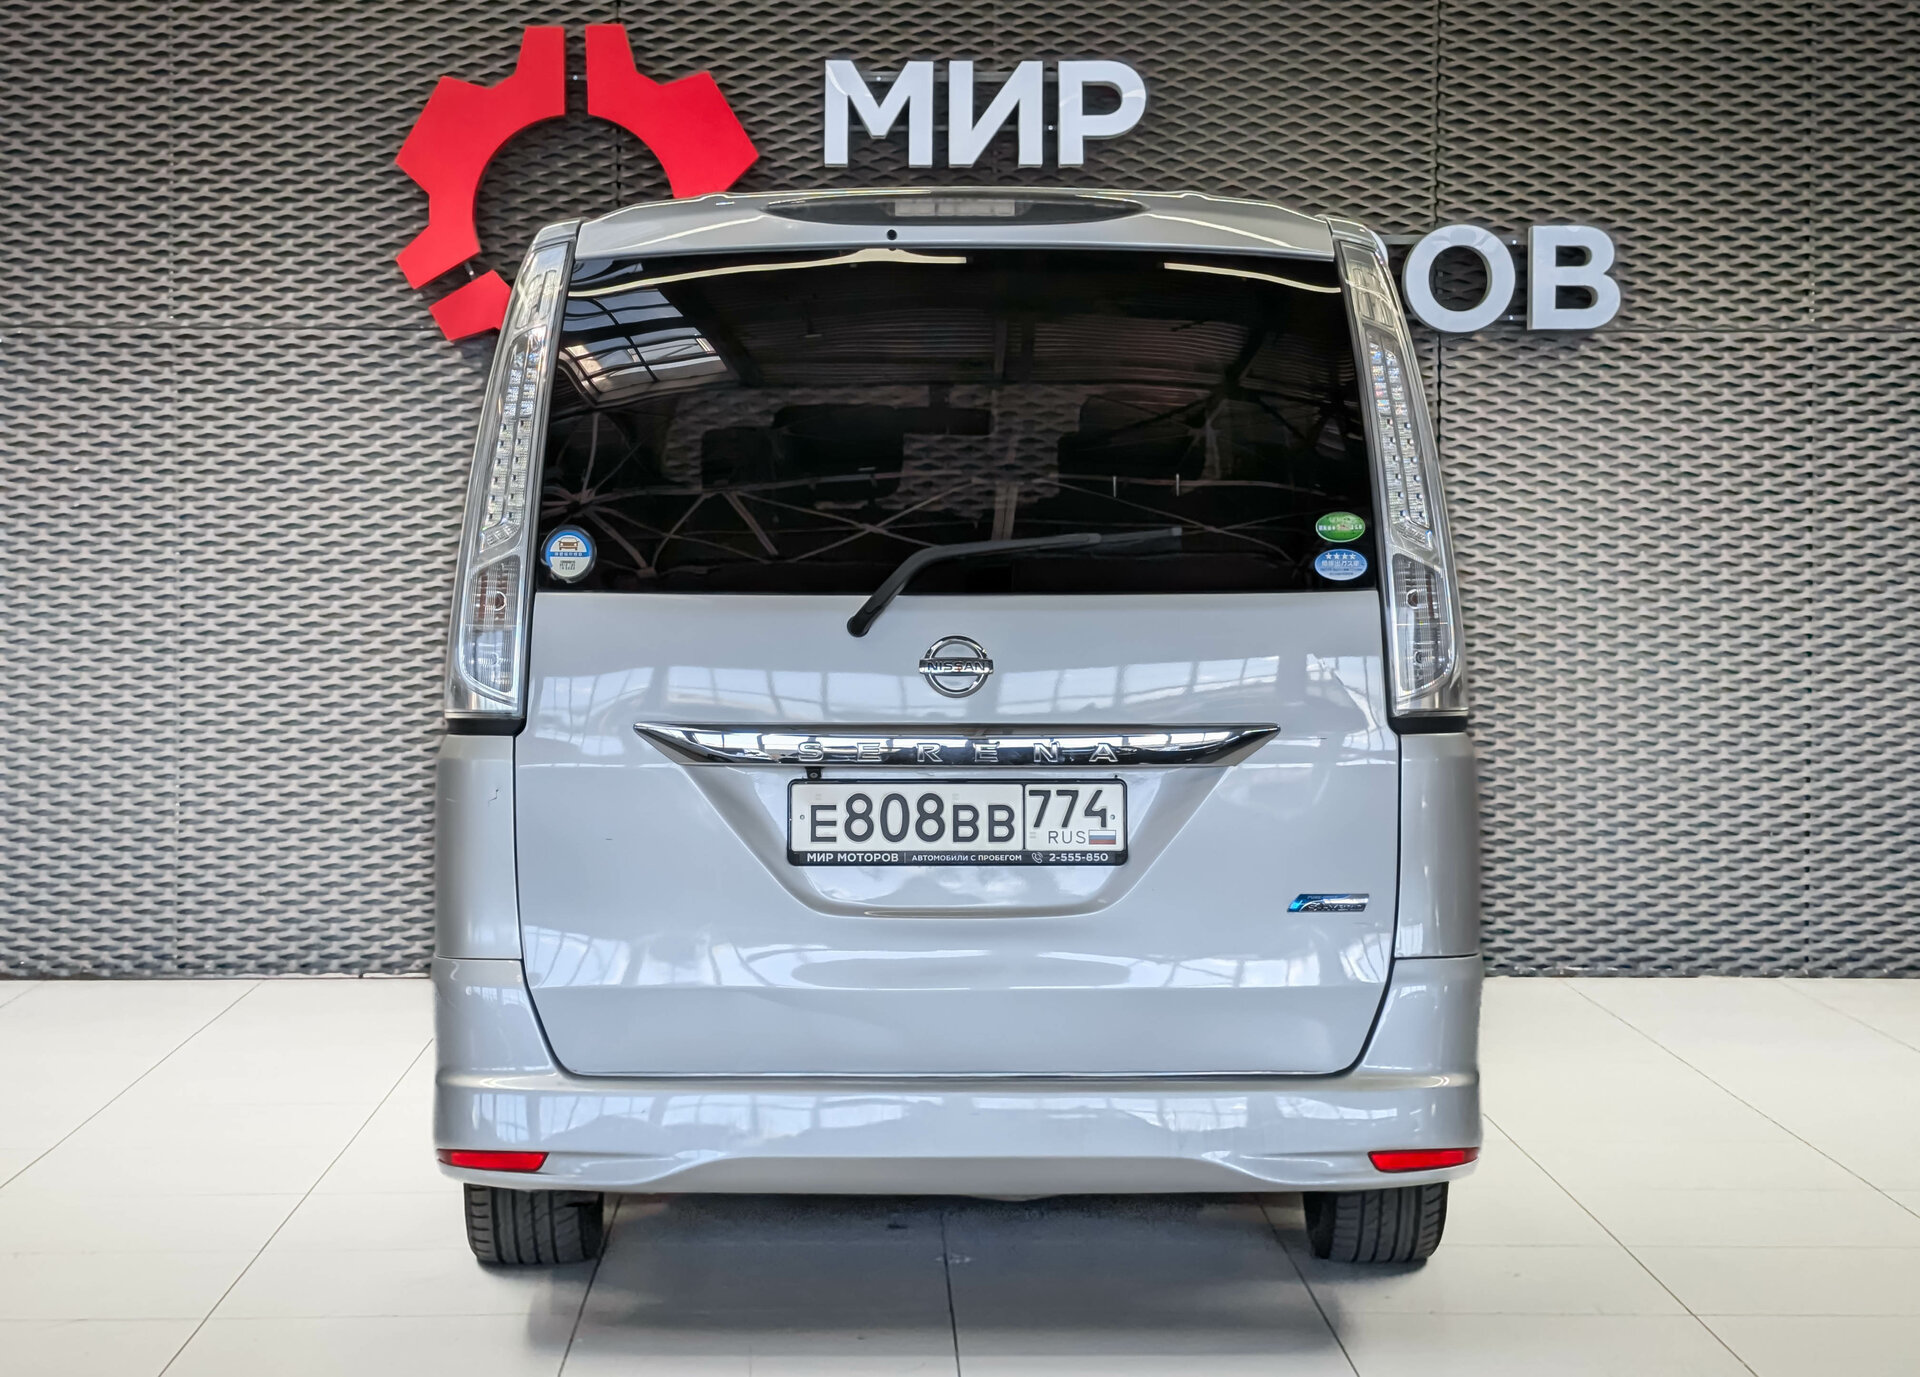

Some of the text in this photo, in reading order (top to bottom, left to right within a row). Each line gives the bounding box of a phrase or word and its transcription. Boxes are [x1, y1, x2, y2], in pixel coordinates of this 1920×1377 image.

[824, 59, 1147, 168] МИР
[927, 662, 985, 671] NISSAN
[797, 741, 1119, 763] SERENA
[810, 789, 1108, 844] Е808ВВ 774
[1048, 830, 1087, 844] RUS
[807, 852, 899, 863] МИР МОТОРОВ
[911, 854, 1022, 862] АВТОМОБИЛИ С ПРОБЕГОМ
[1049, 852, 1109, 862] 2-555-850
